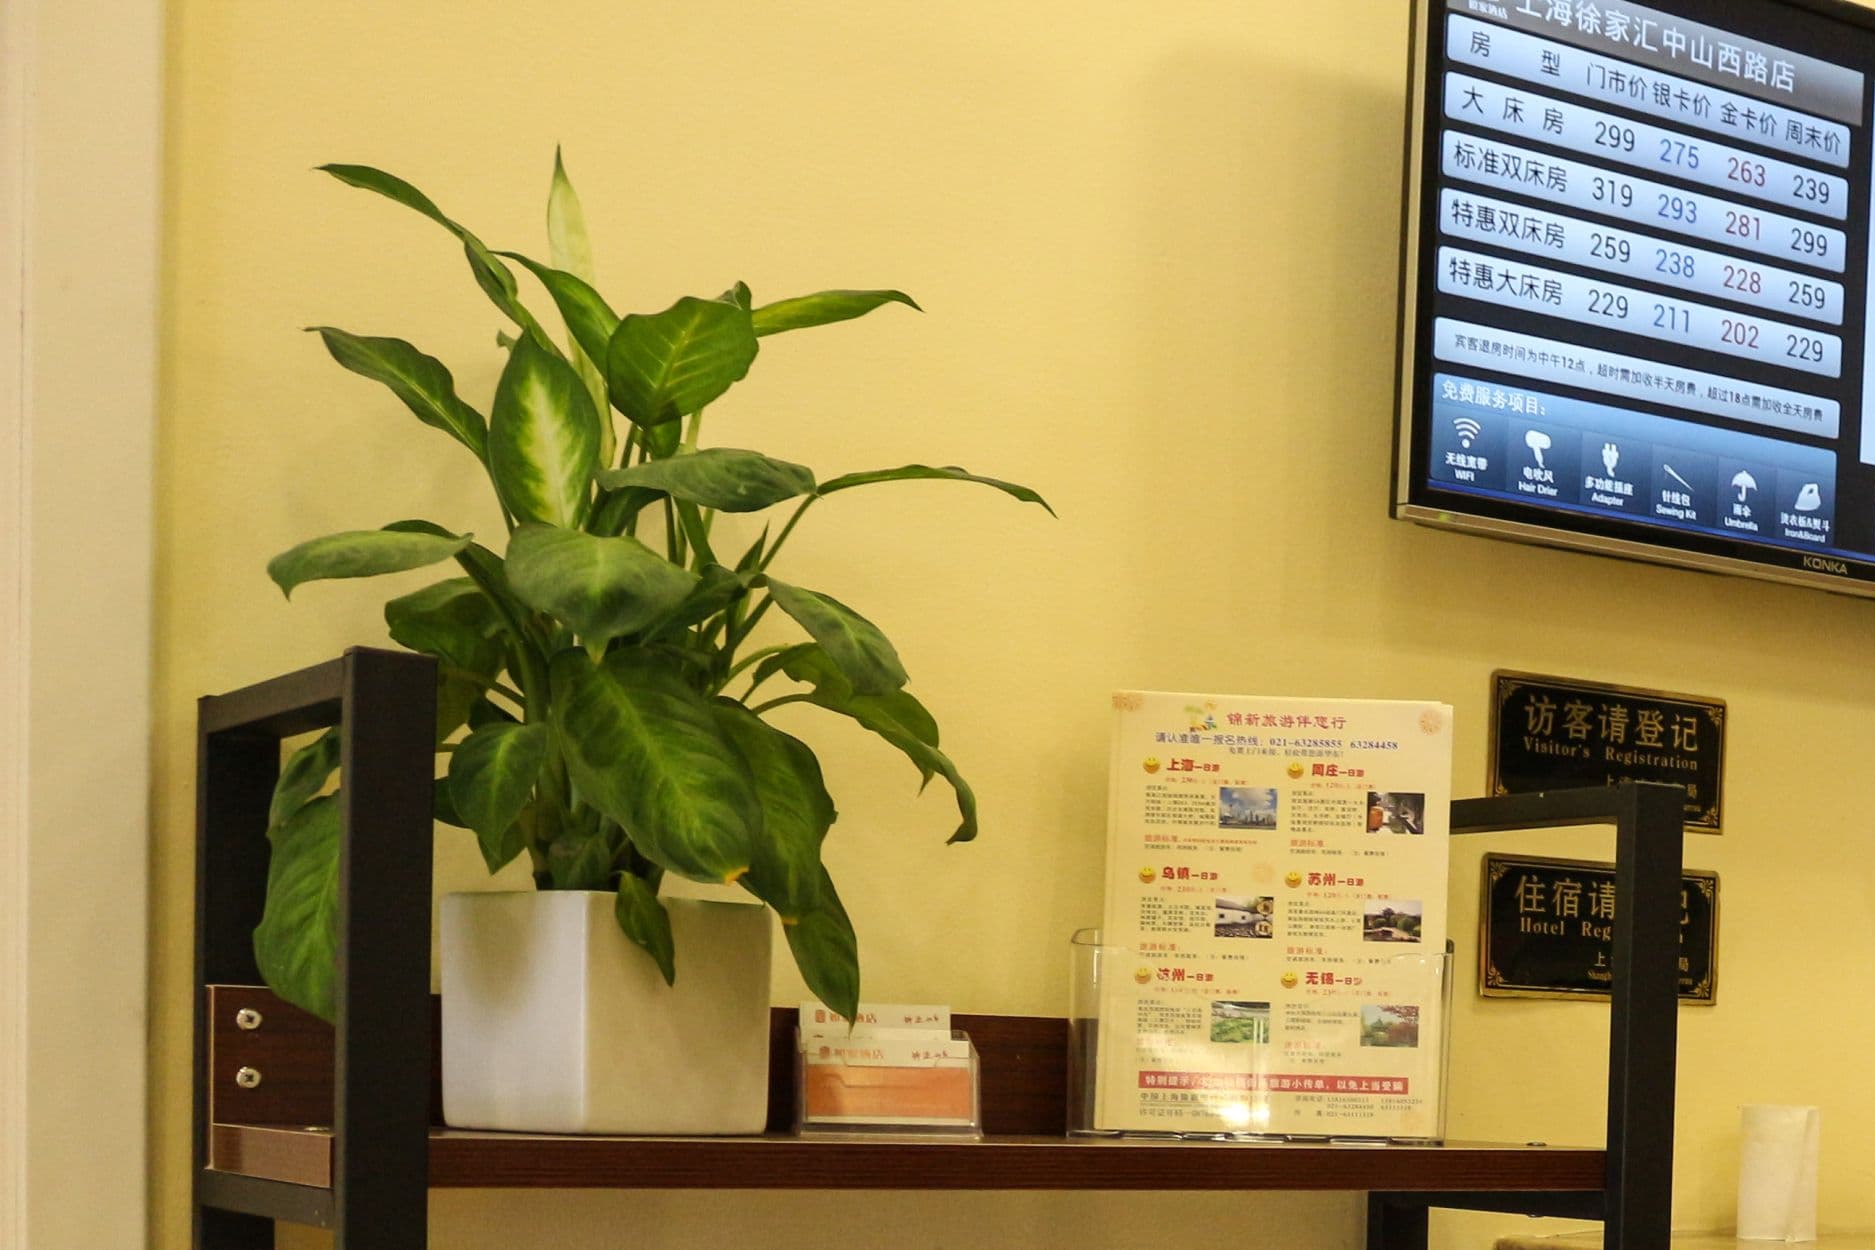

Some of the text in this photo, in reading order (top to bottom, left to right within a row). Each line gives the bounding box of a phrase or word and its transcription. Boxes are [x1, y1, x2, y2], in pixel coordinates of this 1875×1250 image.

[1587, 63, 1647, 101] 门市价
[1653, 81, 1711, 119] 银卡价
[1720, 101, 1777, 137] 金卡价
[1786, 119, 1841, 155] 周末价
[1454, 140, 1828, 257] 标准双床房 319 293 281 299
[1594, 121, 1635, 152] 299
[1660, 138, 1700, 170] 275
[1727, 157, 1766, 187] 263
[1792, 175, 1829, 204] 239
[1451, 199, 1825, 310] 特惠双床房 259 238 228 259
[1449, 257, 1824, 363] 特惠大床房 229 211 202 229
[1803, 555, 1849, 575] KONKA
[1522, 735, 1698, 771] Visitor's Registration
[1523, 695, 1699, 752] 访客请登记
[1520, 916, 1565, 936] Hotel
